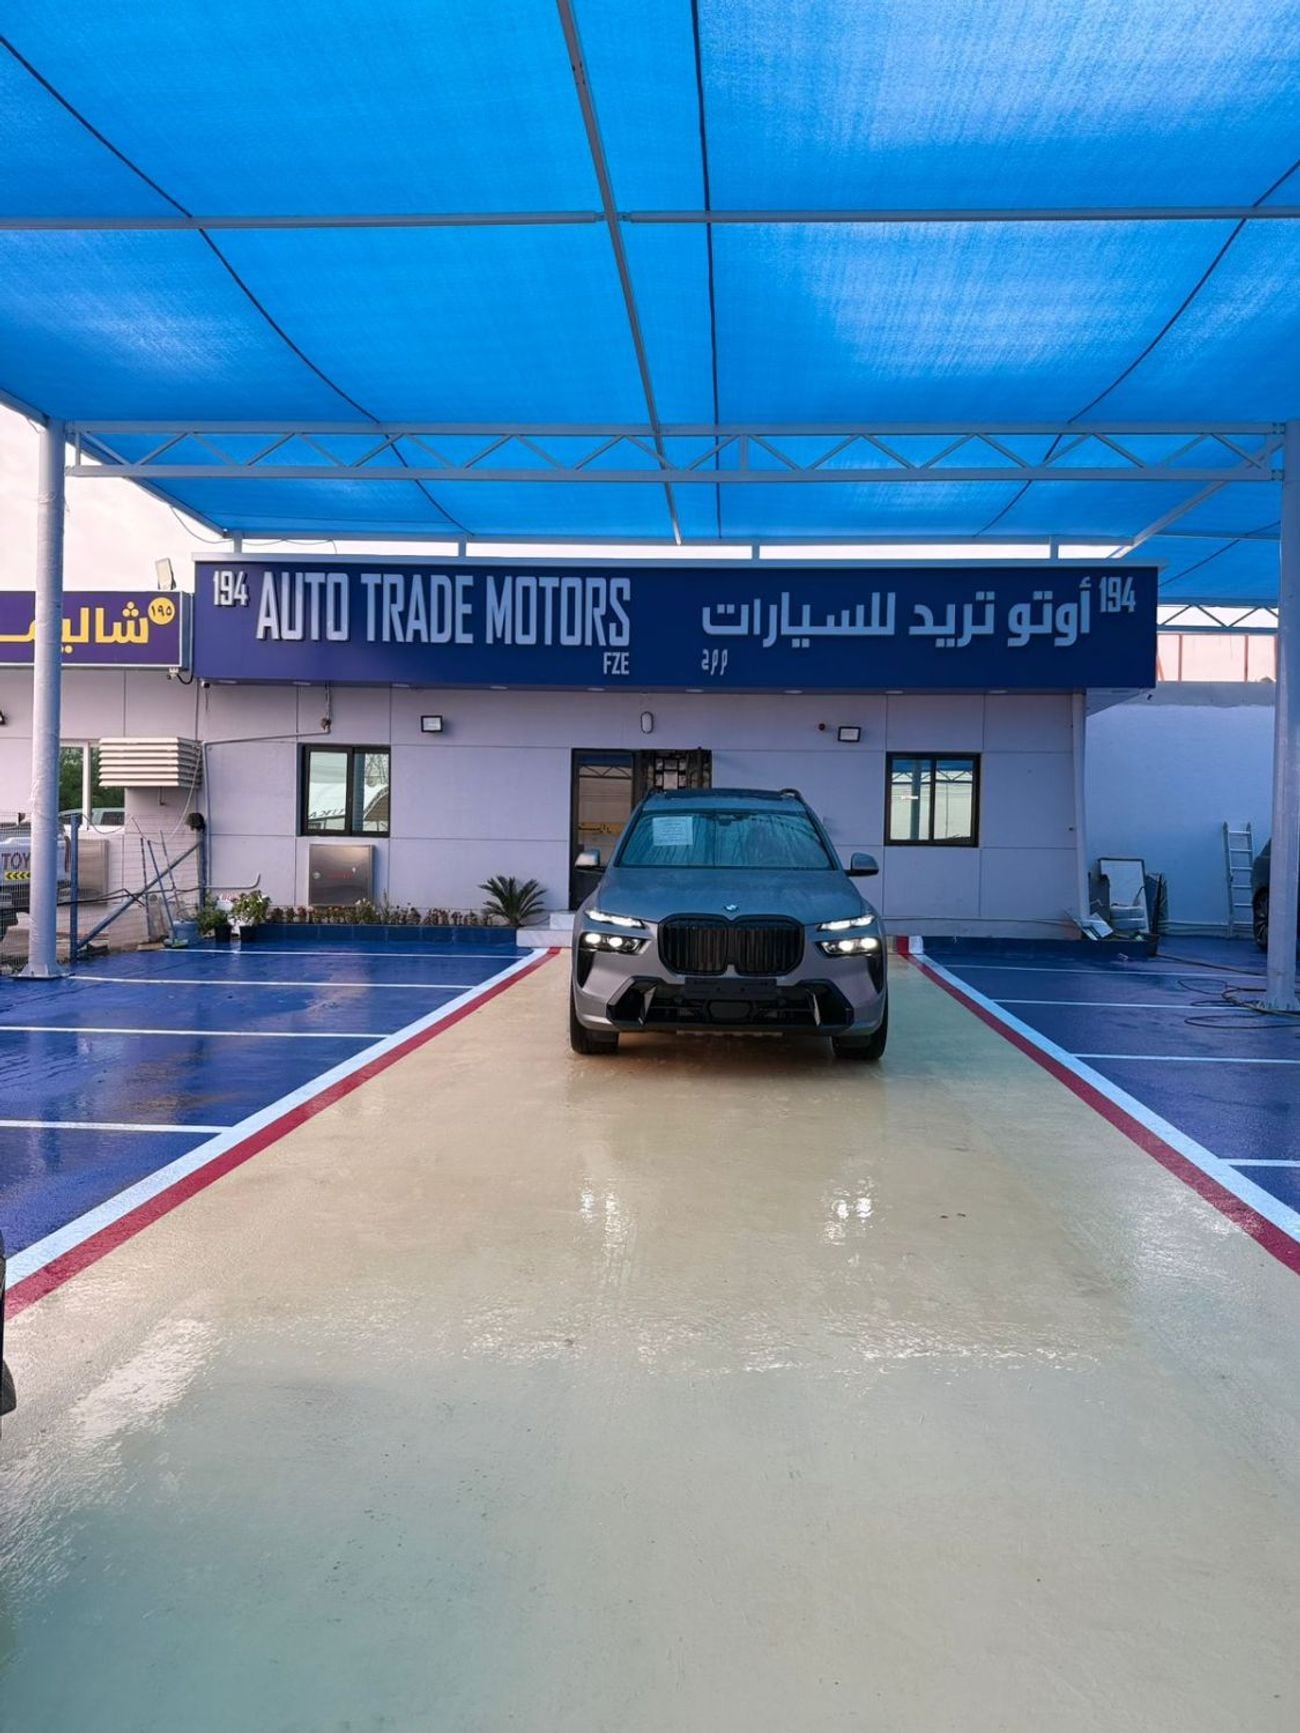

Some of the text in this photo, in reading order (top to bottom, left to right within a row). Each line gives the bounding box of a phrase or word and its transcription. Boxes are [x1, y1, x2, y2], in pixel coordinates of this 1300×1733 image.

[213, 570, 248, 606] 194
[1099, 576, 1136, 613] 194
[256, 571, 631, 647] AUTO TRADE MOTORS
[702, 576, 1091, 648] أوتو تريد للسيارات
[603, 652, 630, 675] FZE
[1, 852, 31, 870] TOY
